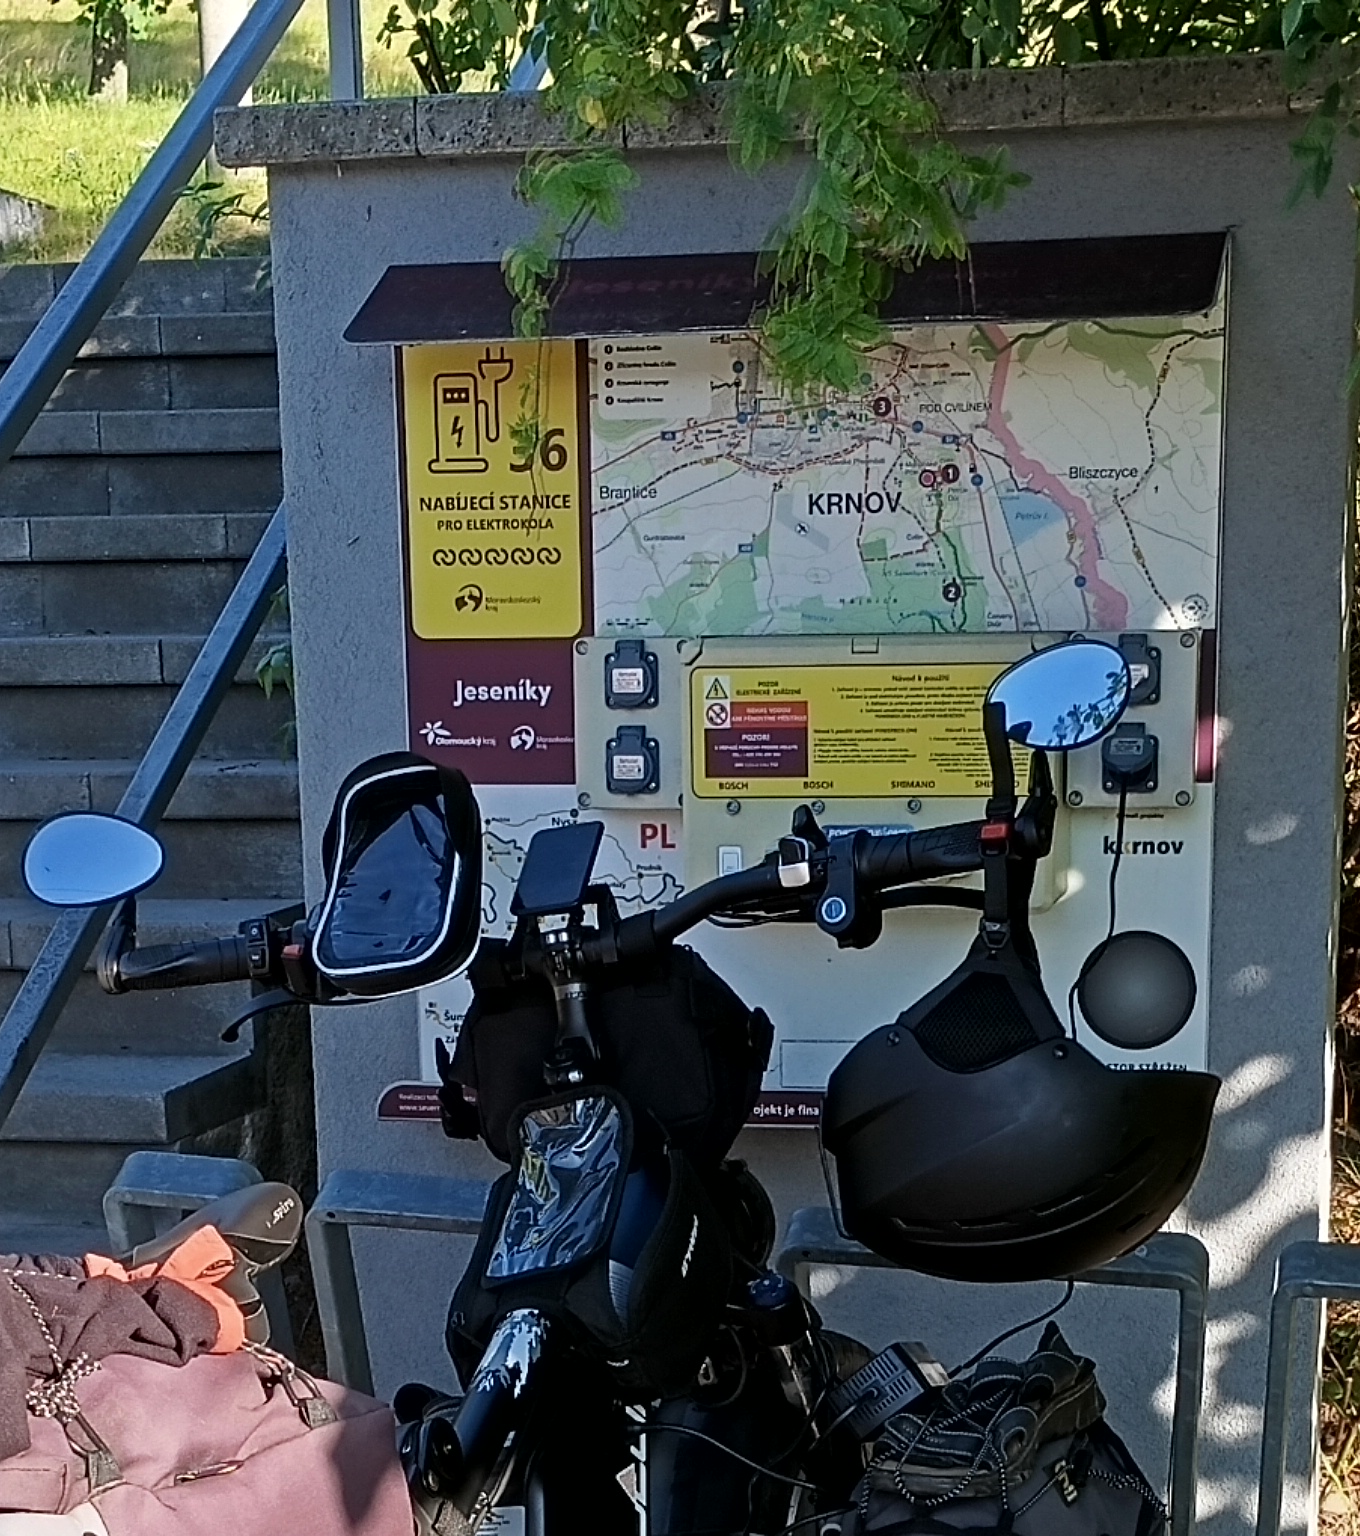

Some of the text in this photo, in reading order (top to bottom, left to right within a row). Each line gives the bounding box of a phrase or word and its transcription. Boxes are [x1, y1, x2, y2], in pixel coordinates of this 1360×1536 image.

[1068, 465, 1139, 481] Bliszczyce
[599, 485, 657, 500] Brantice
[420, 491, 571, 511] NABÍJECÍ STANICE
[808, 492, 902, 515] KRNOV
[437, 518, 554, 531] PRO ELEKTROKOLA
[453, 678, 552, 707] Jeseníky
[435, 736, 482, 748] Olomoucký
[719, 781, 749, 790] BOSCH
[803, 780, 833, 789] BOSCH
[891, 780, 936, 789] SHIMANO
[640, 823, 676, 849] PL
[784, 1103, 795, 1117] je
[797, 1103, 820, 1116] fina
